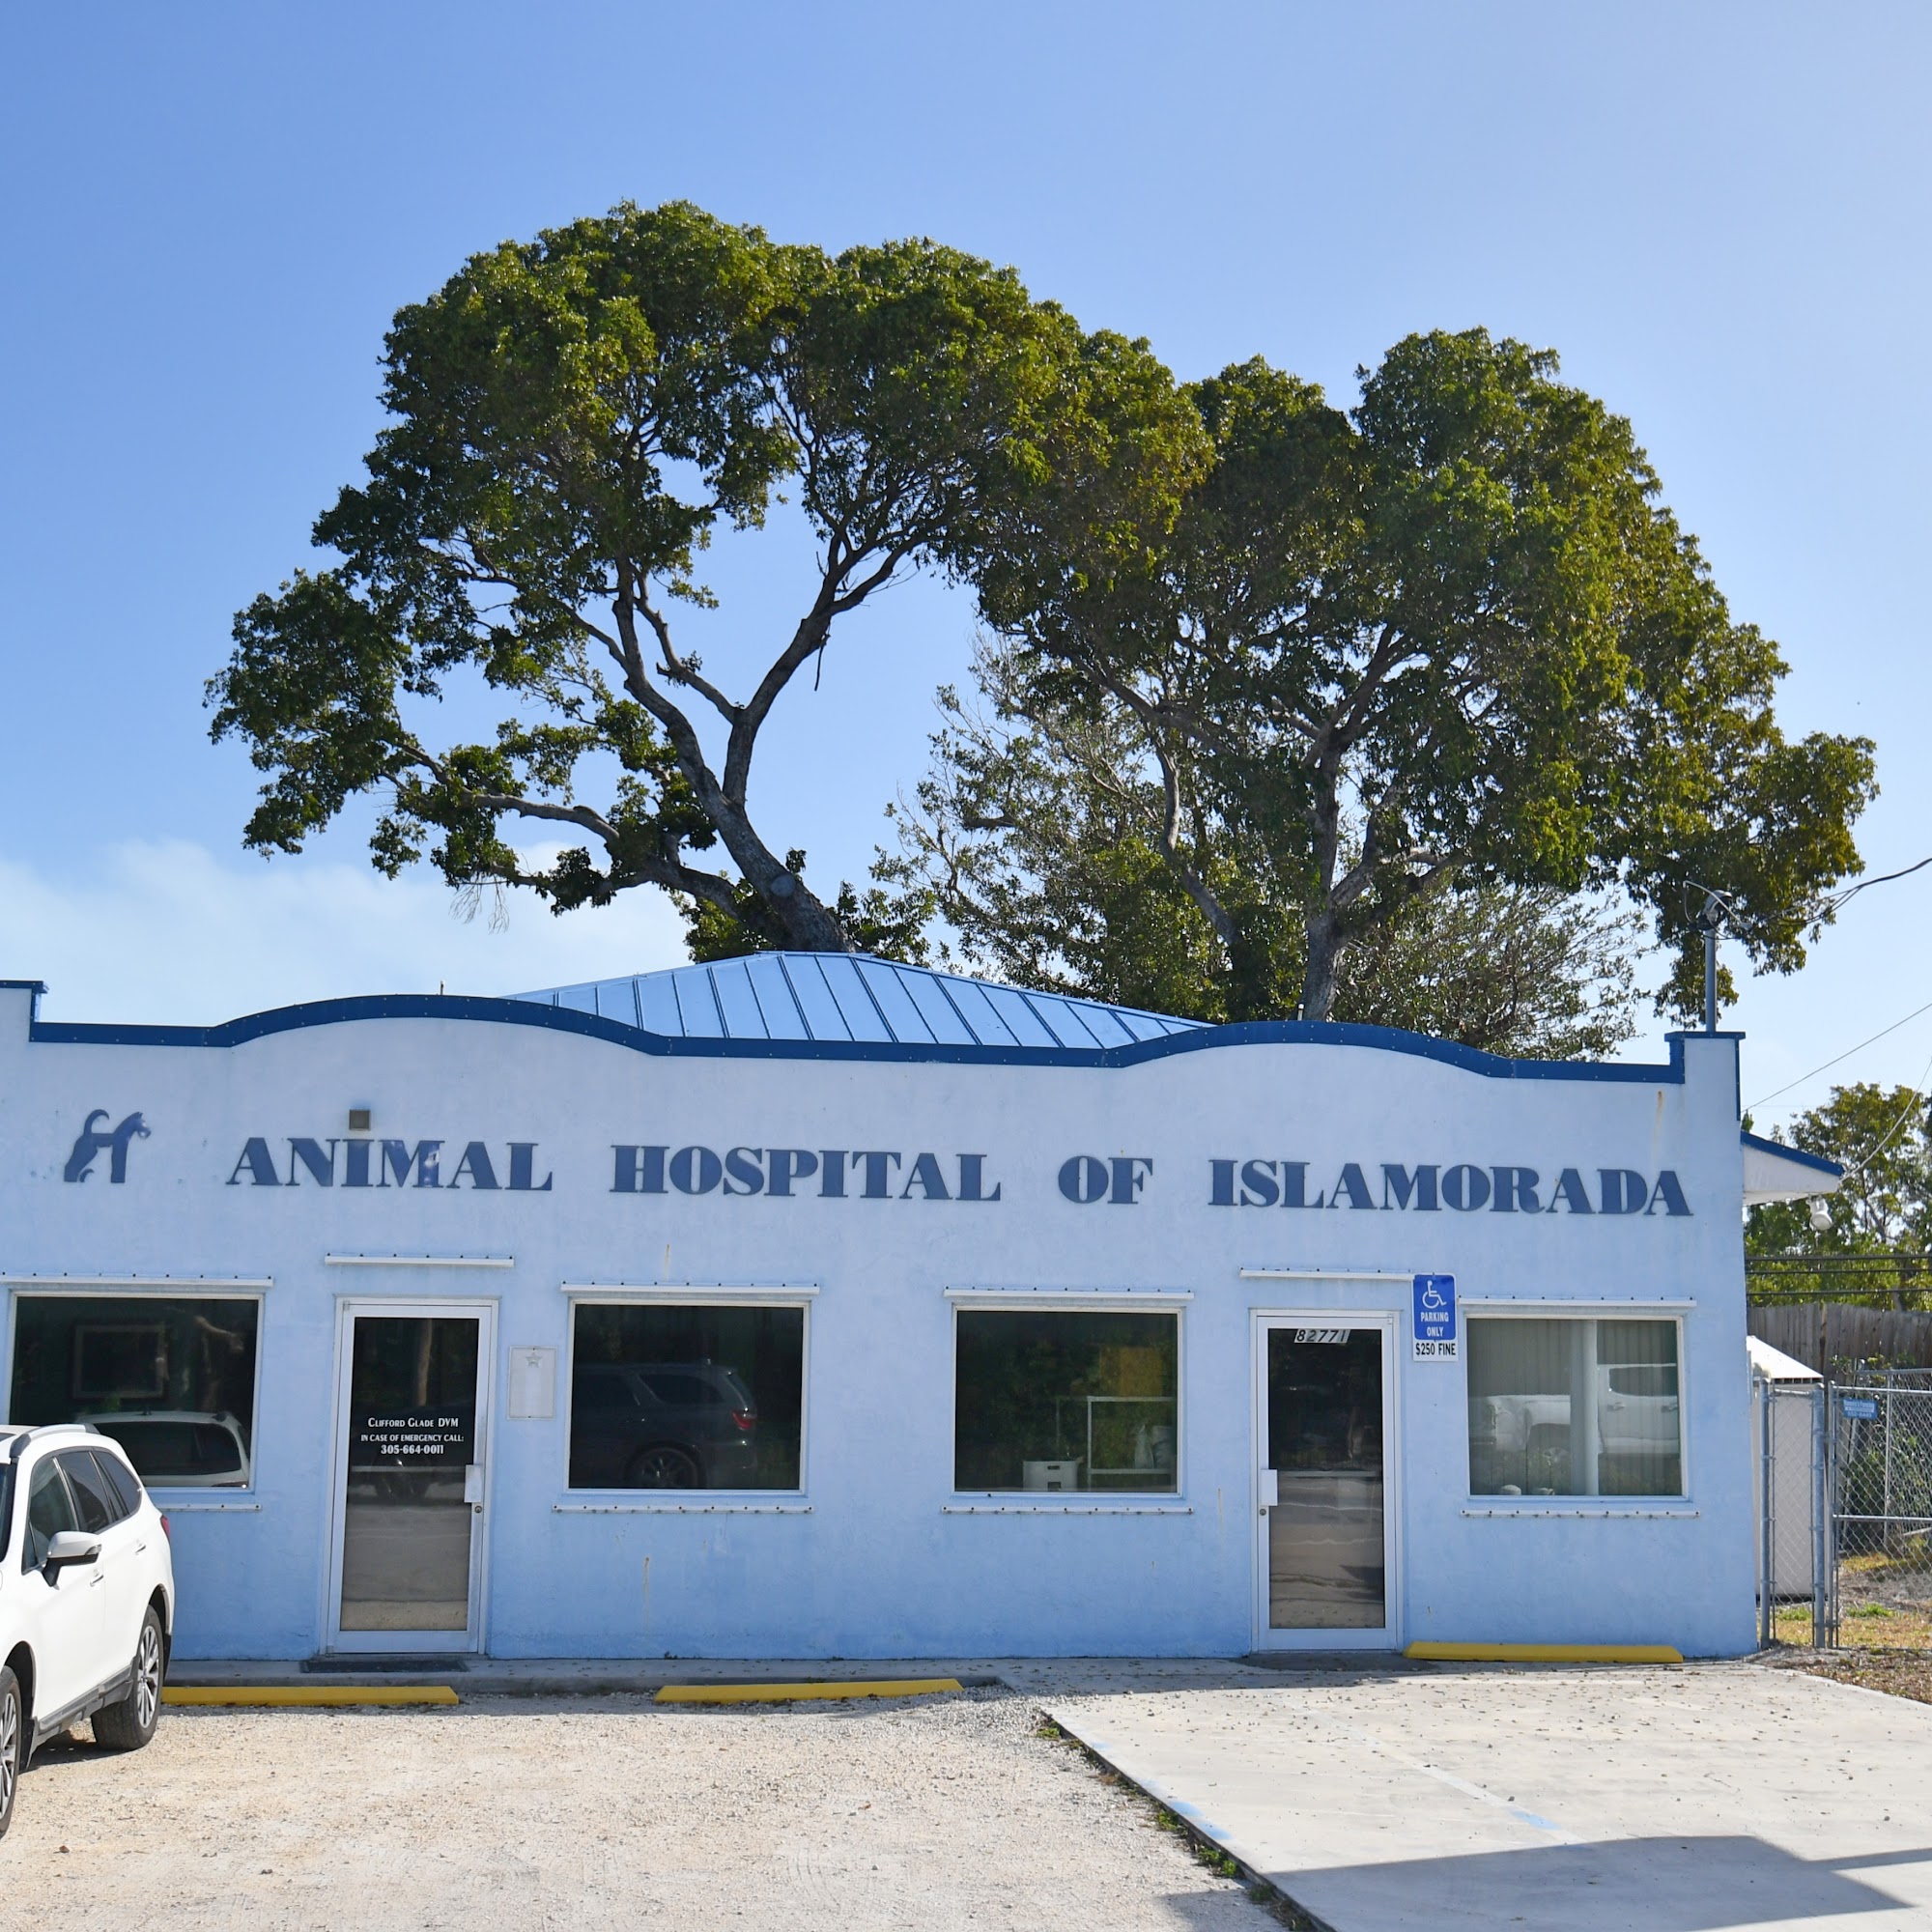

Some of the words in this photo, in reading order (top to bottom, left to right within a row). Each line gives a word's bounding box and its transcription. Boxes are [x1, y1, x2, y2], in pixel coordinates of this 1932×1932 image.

[226, 1136, 553, 1191] ANIMAL
[609, 1144, 1002, 1203] HOSPITAL
[1057, 1154, 1153, 1206] OF
[1208, 1158, 1694, 1218] ISLAMORADA
[1420, 1311, 1449, 1322] PARKING
[1296, 1329, 1346, 1343] 82771
[1426, 1325, 1444, 1337] ONLY
[1415, 1342, 1435, 1356] $250
[1438, 1343, 1457, 1356] FINE
[367, 1417, 406, 1428] CLIFFORD
[408, 1417, 435, 1428] GLADE
[438, 1417, 459, 1428] DVM
[369, 1434, 388, 1442] CASE
[389, 1434, 400, 1442] OF
[400, 1434, 442, 1442] EMERGENCY
[443, 1434, 465, 1442] CALL:
[381, 1444, 444, 1455] 305-664-0011
